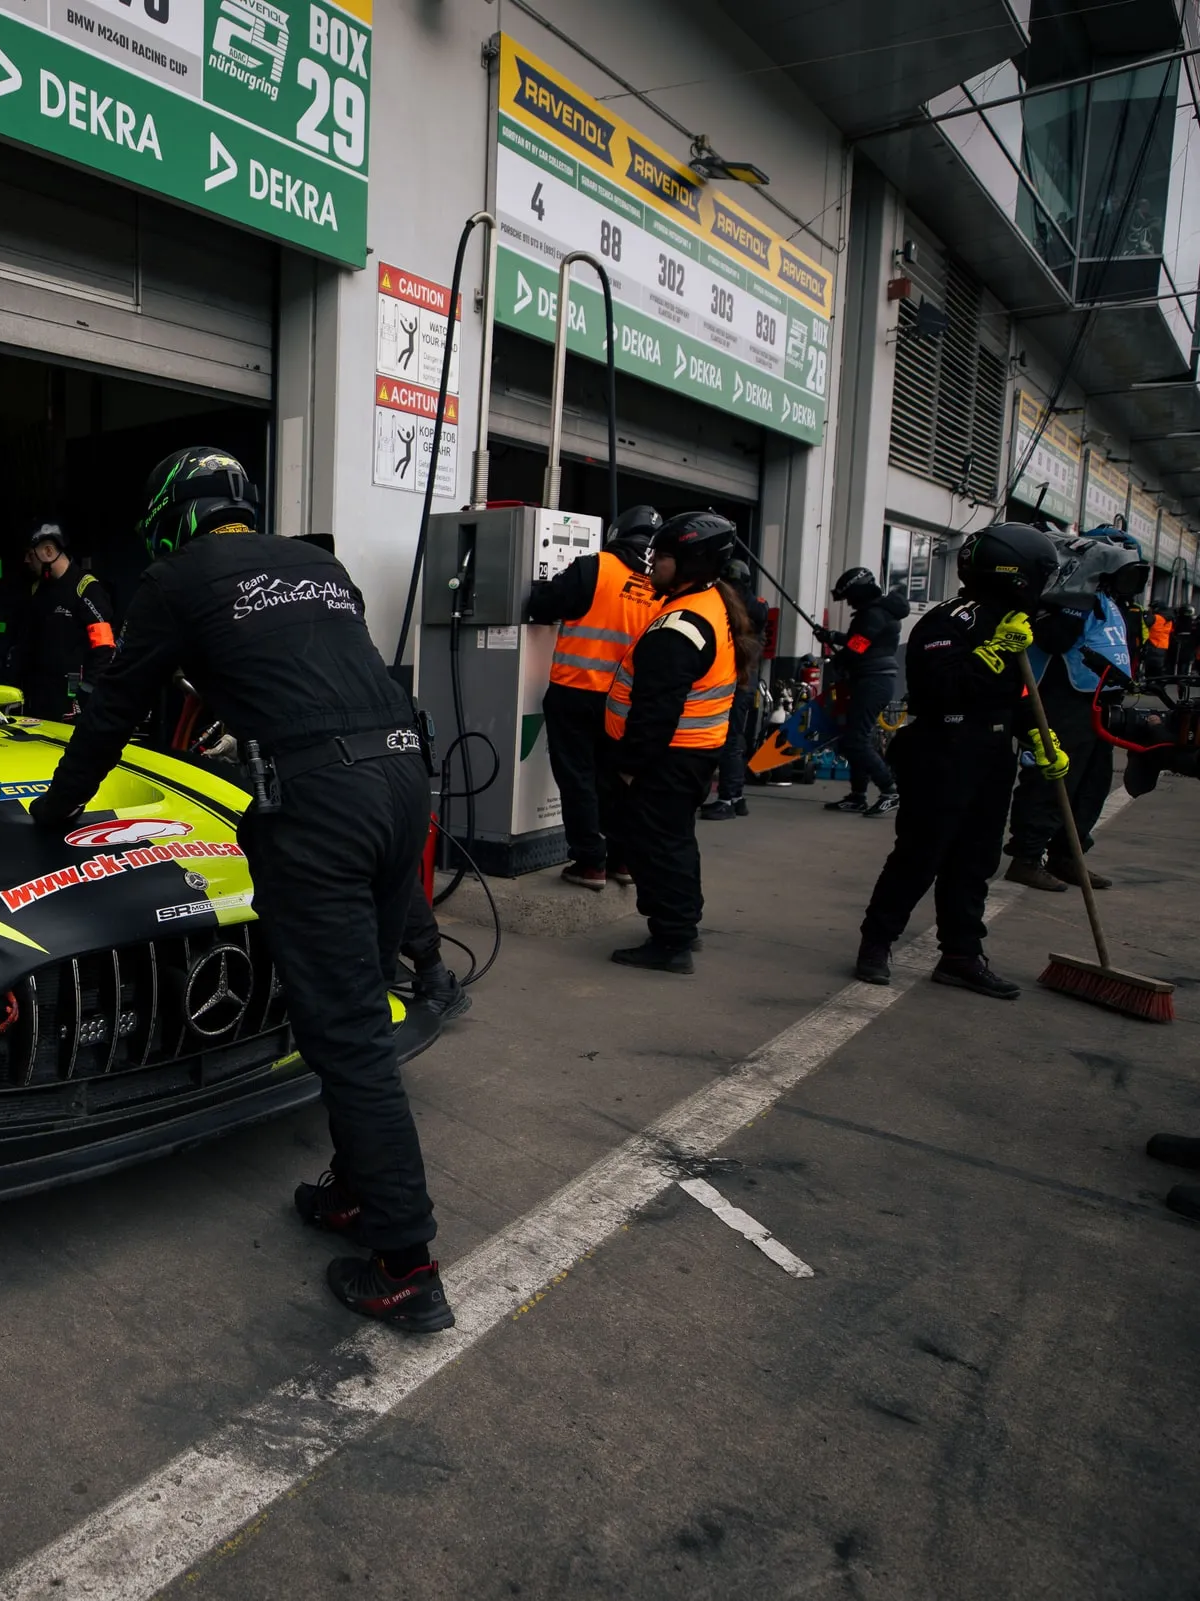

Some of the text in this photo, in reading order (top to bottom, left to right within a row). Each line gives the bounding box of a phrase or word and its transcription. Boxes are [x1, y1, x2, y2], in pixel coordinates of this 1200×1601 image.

[67, 8, 95, 33] BMW
[97, 23, 129, 50] M240I
[132, 40, 167, 68] RACING
[169, 58, 188, 77] CUP
[229, 48, 247, 65] ADAC
[309, 3, 368, 80] BOX
[208, 53, 279, 101] nürburgring
[40, 68, 163, 161] DEKRA
[296, 57, 366, 167] 29
[524, 76, 608, 151] RAVENOL
[250, 159, 338, 232] DEKRA
[633, 153, 697, 212] RAVENOL
[531, 181, 545, 221] 4
[501, 222, 521, 240] PORSCHE
[601, 219, 622, 262] 88
[717, 214, 767, 260] RAVENOL
[399, 277, 444, 308] CAUTION
[658, 253, 685, 297] 302
[783, 261, 823, 298] RAVENOL
[538, 287, 586, 335] DERA
[711, 283, 734, 322] 303
[421, 332, 458, 353] YOUR HD
[429, 321, 448, 337] WATC
[756, 310, 777, 345] 830
[812, 318, 829, 349] BOX
[622, 325, 661, 367] DEKRA
[689, 356, 722, 391] DEKRA
[806, 345, 827, 395] 28
[391, 386, 447, 415] ACHTUN
[746, 381, 773, 412] DEKRA
[792, 401, 816, 430] DEKRA
[237, 573, 269, 593] Team
[540, 564, 548, 578] 29
[326, 599, 357, 615] Racing
[1005, 632, 1027, 641] OMP
[1103, 626, 1128, 646] TV
[1114, 652, 1128, 665] 30
[944, 714, 964, 724] OMP
[158, 904, 191, 920] SR
[392, 1289, 411, 1303] SPEED
